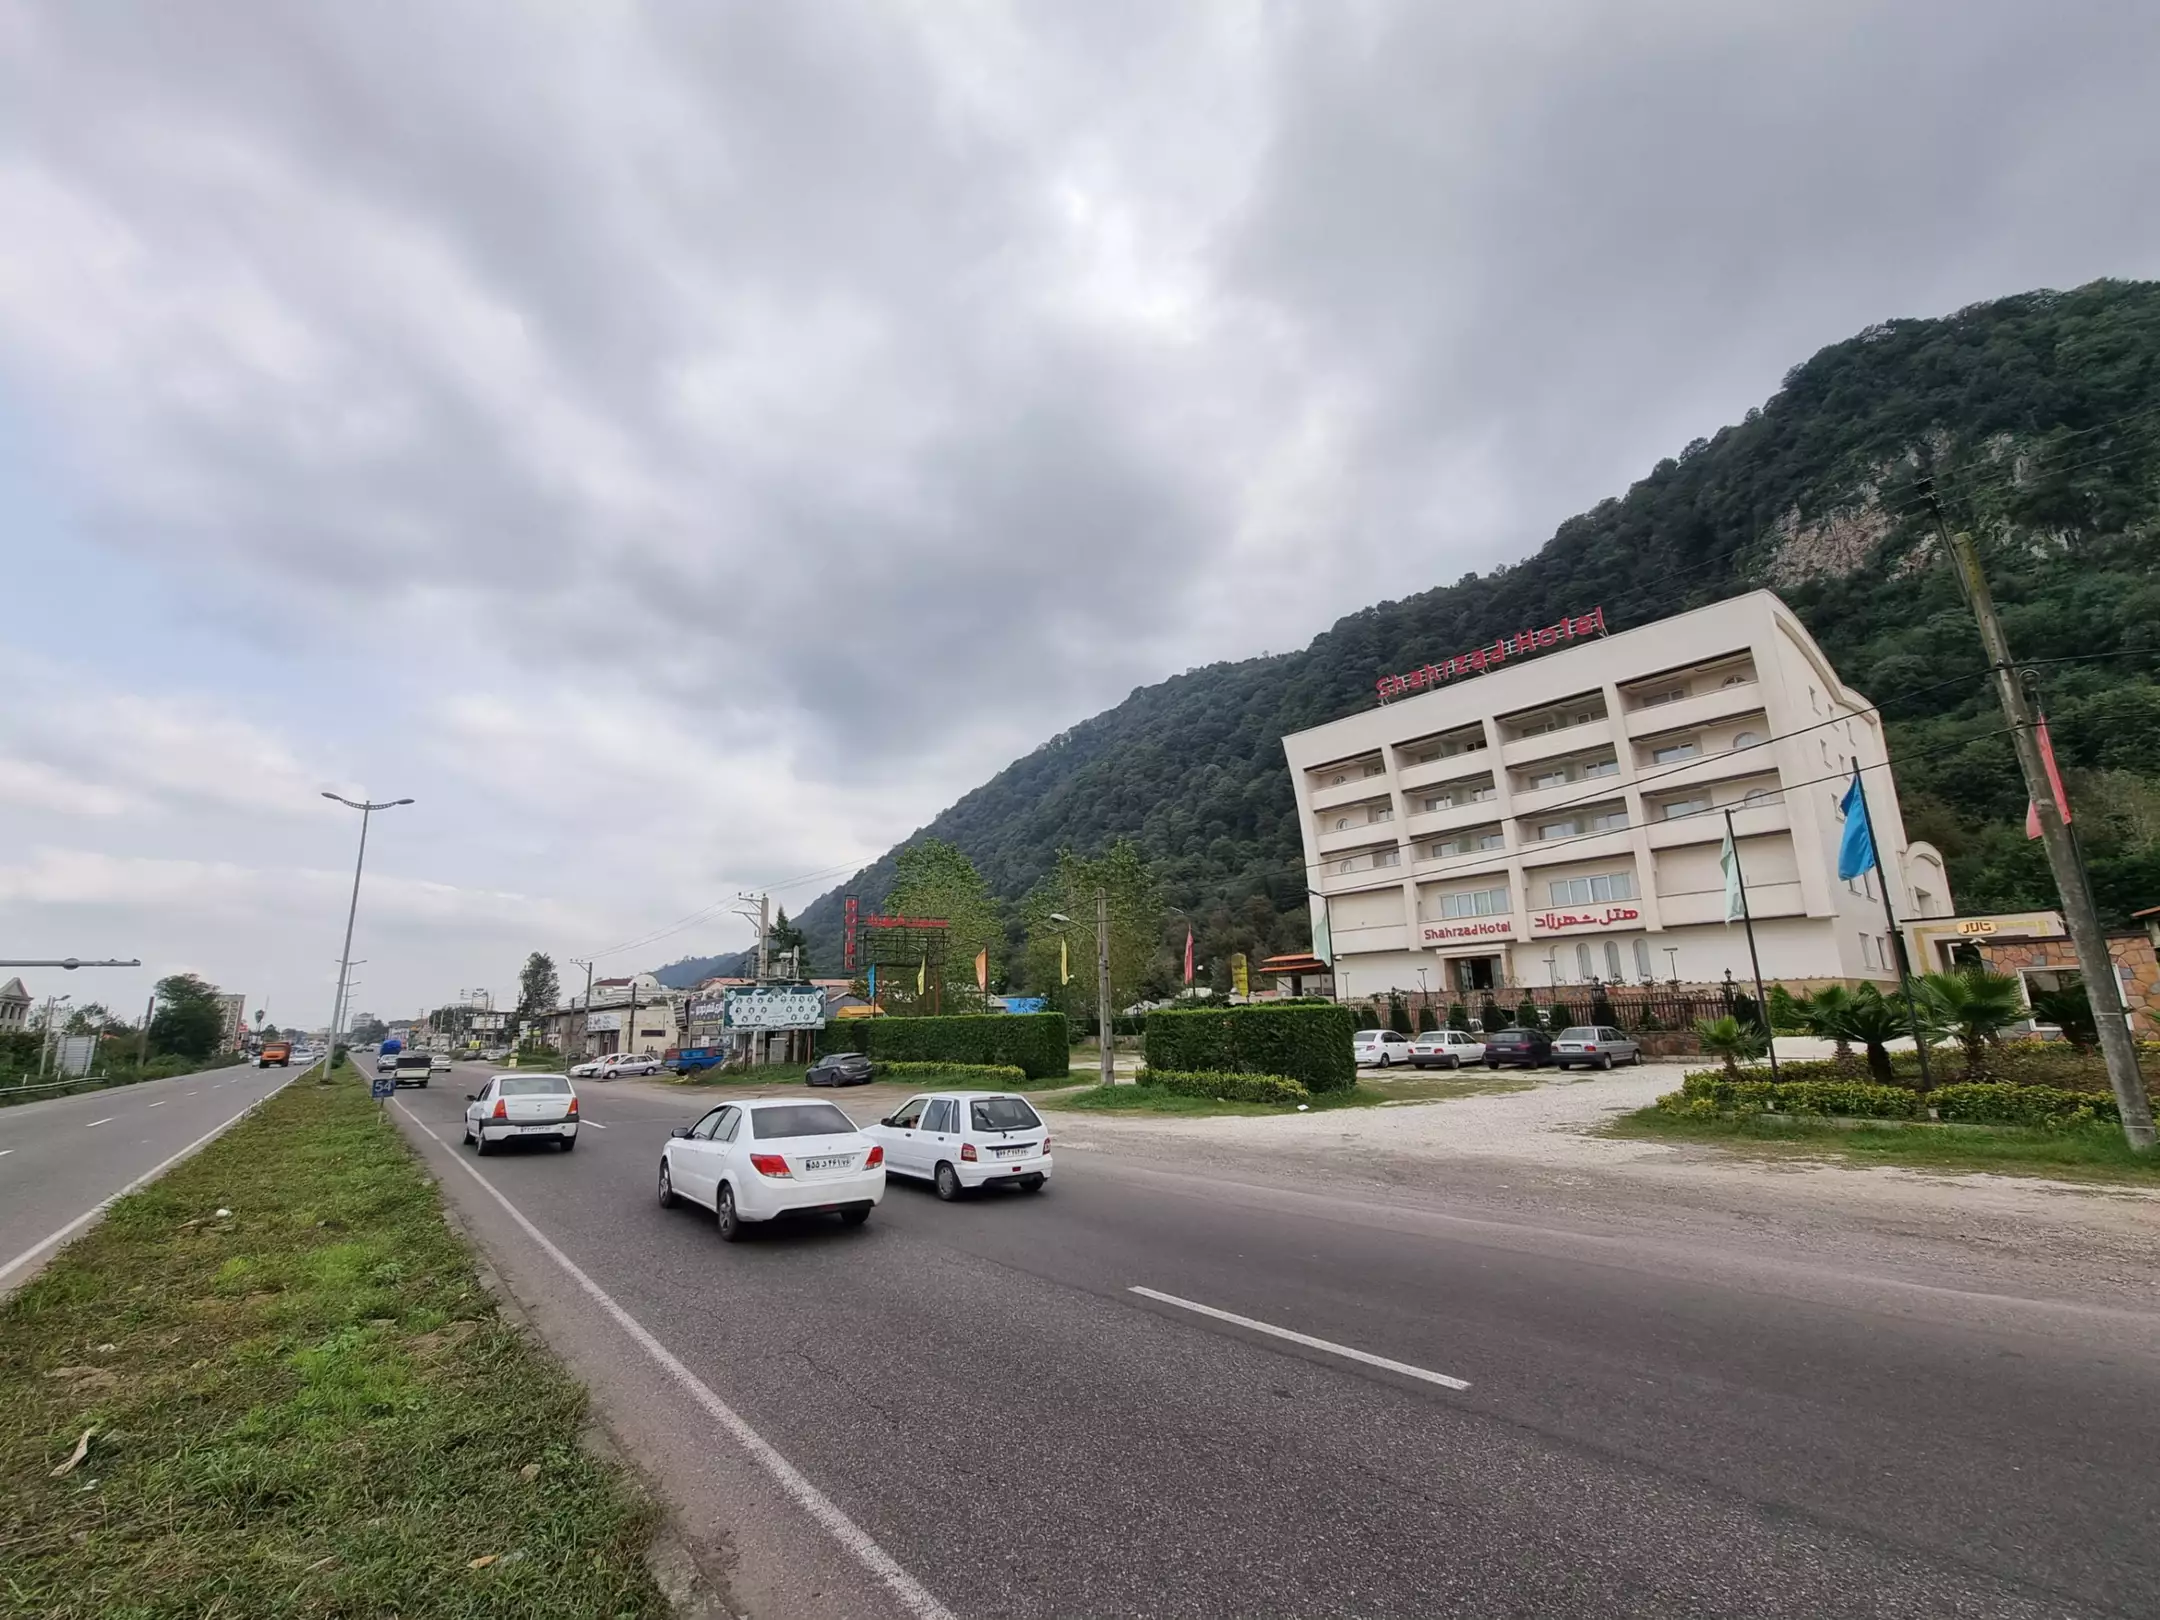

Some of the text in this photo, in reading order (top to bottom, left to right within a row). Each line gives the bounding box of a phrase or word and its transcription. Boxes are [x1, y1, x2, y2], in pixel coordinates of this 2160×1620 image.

[1376, 606, 1604, 698] Shahrzad Hotel
[1534, 908, 1639, 930] هتل شهرزاد
[1963, 921, 1992, 934] تالار
[1424, 921, 1512, 940] Shahrzad Hotel
[375, 1080, 392, 1092] 54
